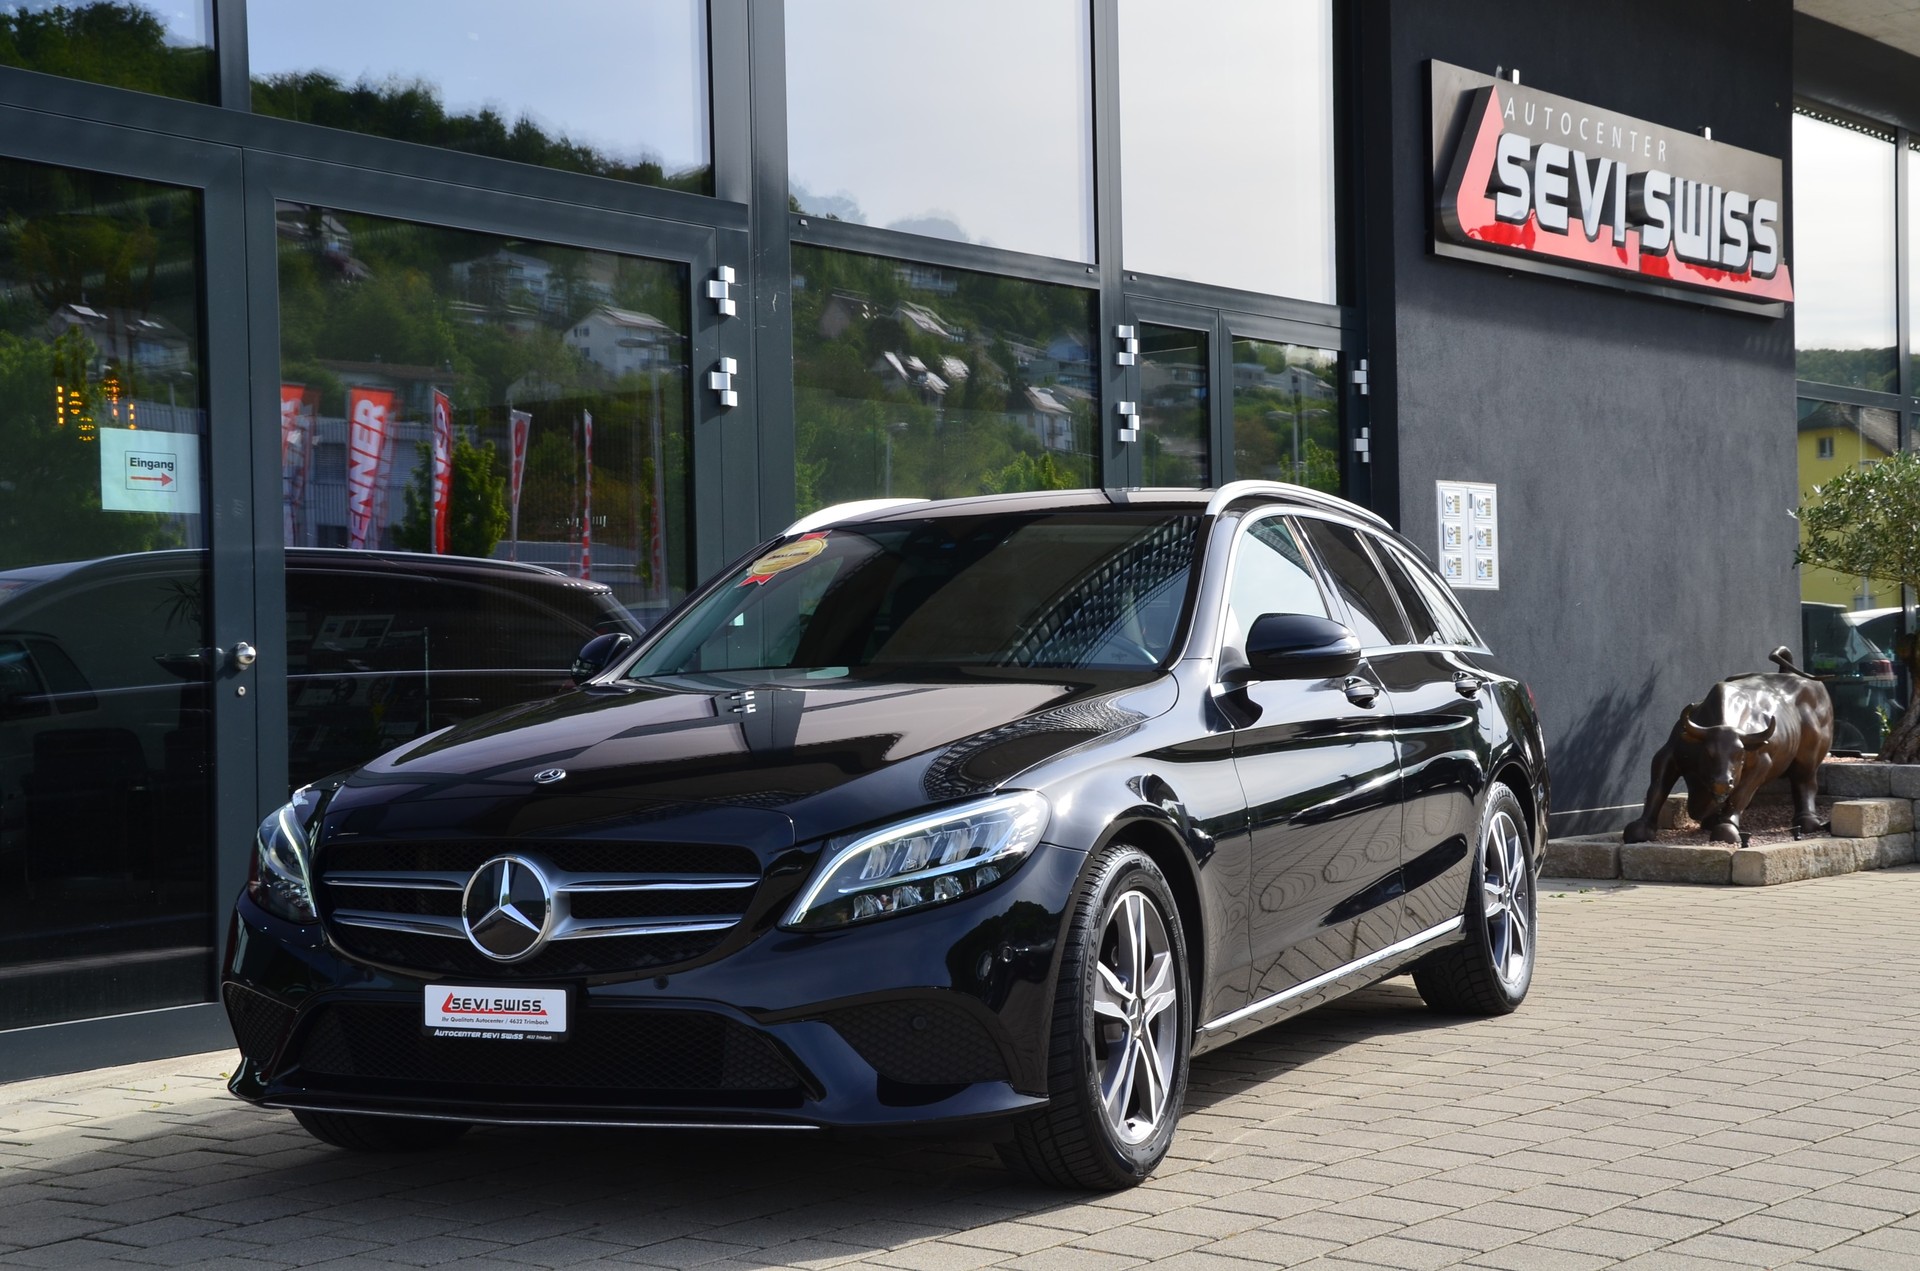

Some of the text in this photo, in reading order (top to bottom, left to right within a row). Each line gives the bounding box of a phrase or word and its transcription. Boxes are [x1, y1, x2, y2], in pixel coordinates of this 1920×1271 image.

[1503, 97, 1668, 162] AUTOCENTER
[1495, 132, 1778, 276] SEVI SWISS
[129, 456, 174, 472] Eingang
[451, 997, 542, 1012] SEVI SWISS
[524, 1018, 549, 1026] Trimbach
[481, 1031, 500, 1039] SEVI
